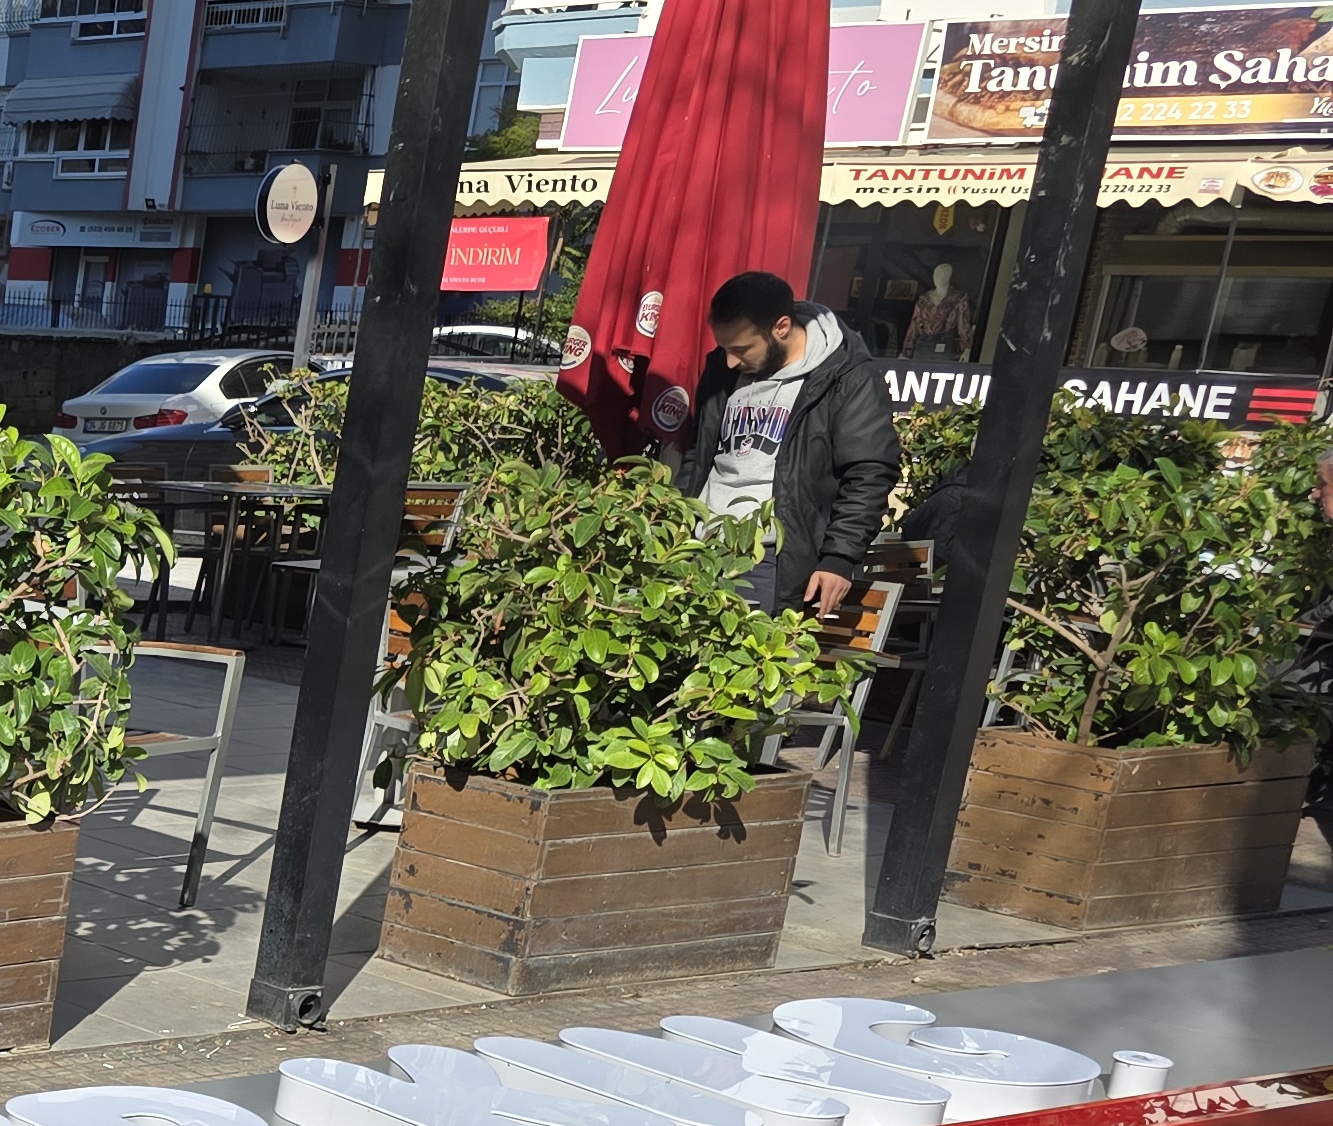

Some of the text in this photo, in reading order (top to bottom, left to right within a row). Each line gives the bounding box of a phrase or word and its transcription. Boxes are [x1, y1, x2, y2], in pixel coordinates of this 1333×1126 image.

[1140, 102, 1182, 121] 224
[1188, 101, 1218, 120] 22
[1223, 99, 1253, 119] 33
[503, 172, 598, 194] Viento
[855, 184, 941, 195] mersin
[1112, 185, 1134, 193] 224
[1137, 185, 1153, 193] 22
[1156, 184, 1172, 193] 33
[270, 200, 314, 211] Luna Viento
[449, 242, 522, 266] İNDİRİM
[657, 402, 686, 422] KING
